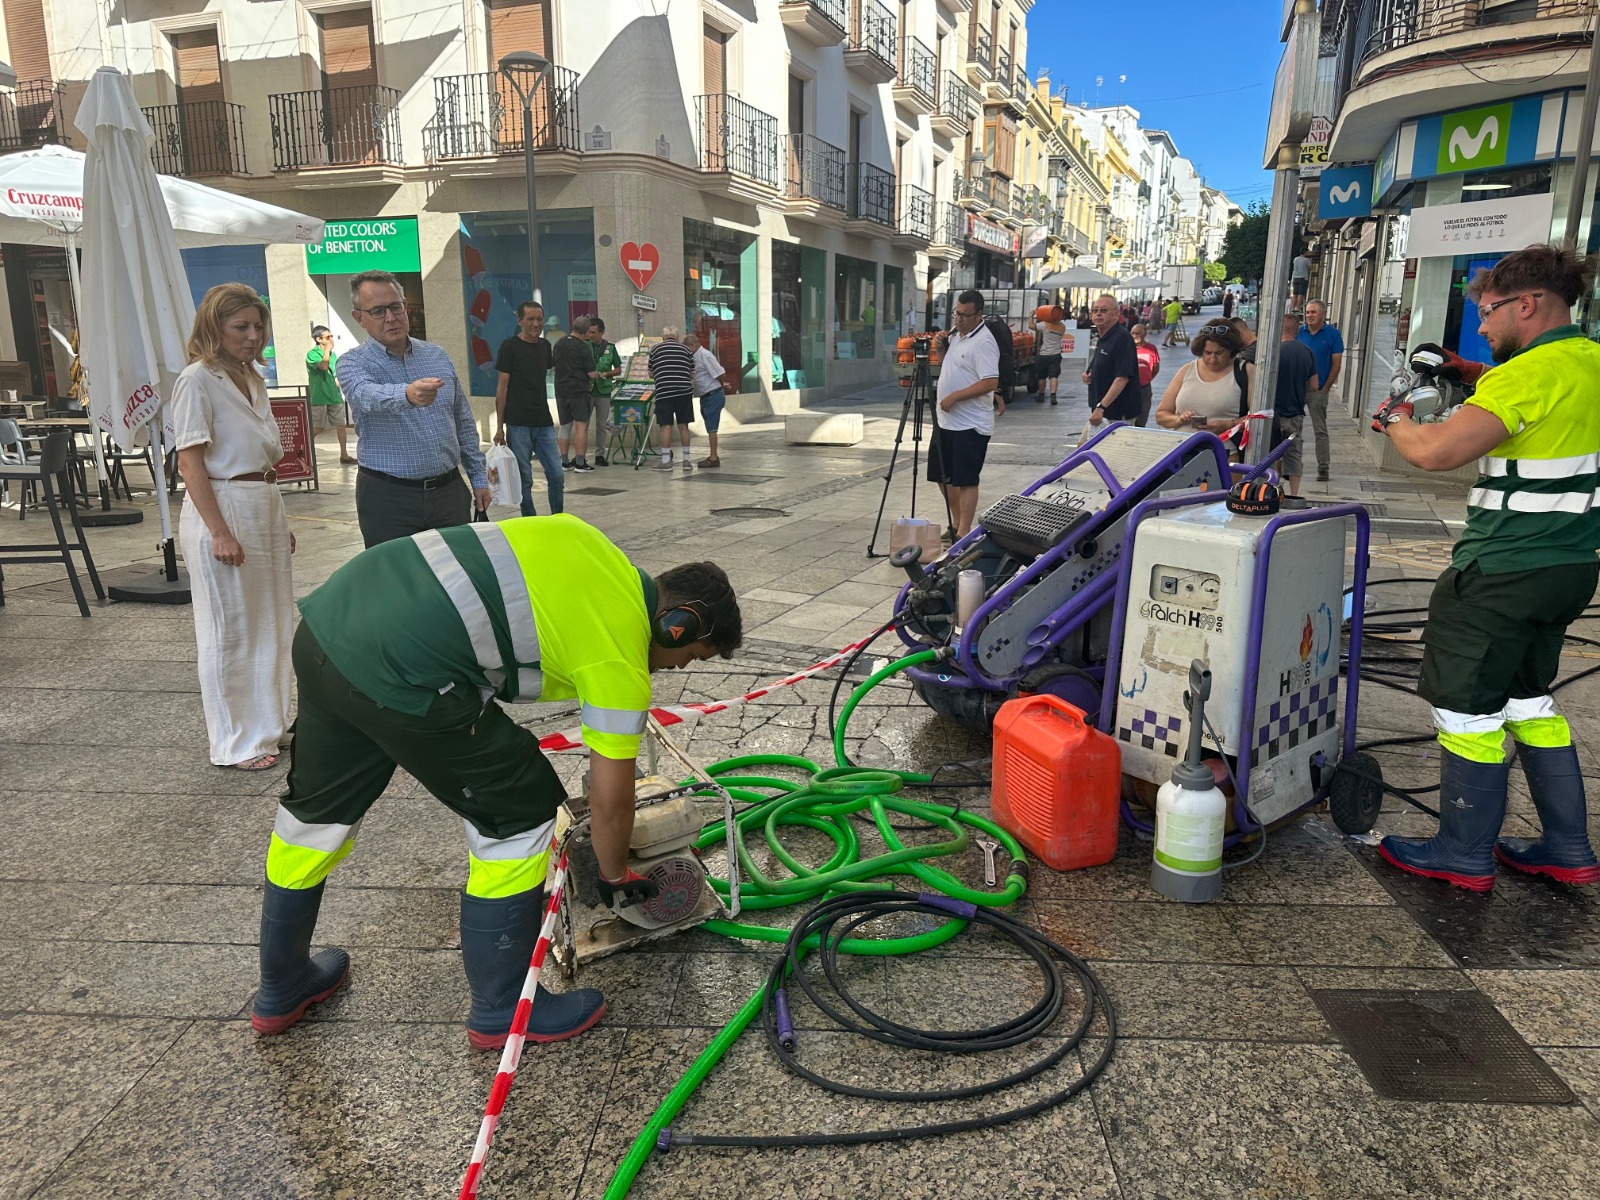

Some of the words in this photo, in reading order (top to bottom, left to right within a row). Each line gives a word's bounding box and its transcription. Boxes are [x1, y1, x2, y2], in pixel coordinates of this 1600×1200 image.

[1311, 120, 1329, 131] ERIA
[1300, 153, 1328, 164] RO
[7, 188, 84, 212] Cruzcamp
[324, 224, 348, 238] ITED
[349, 222, 397, 237] COLORS
